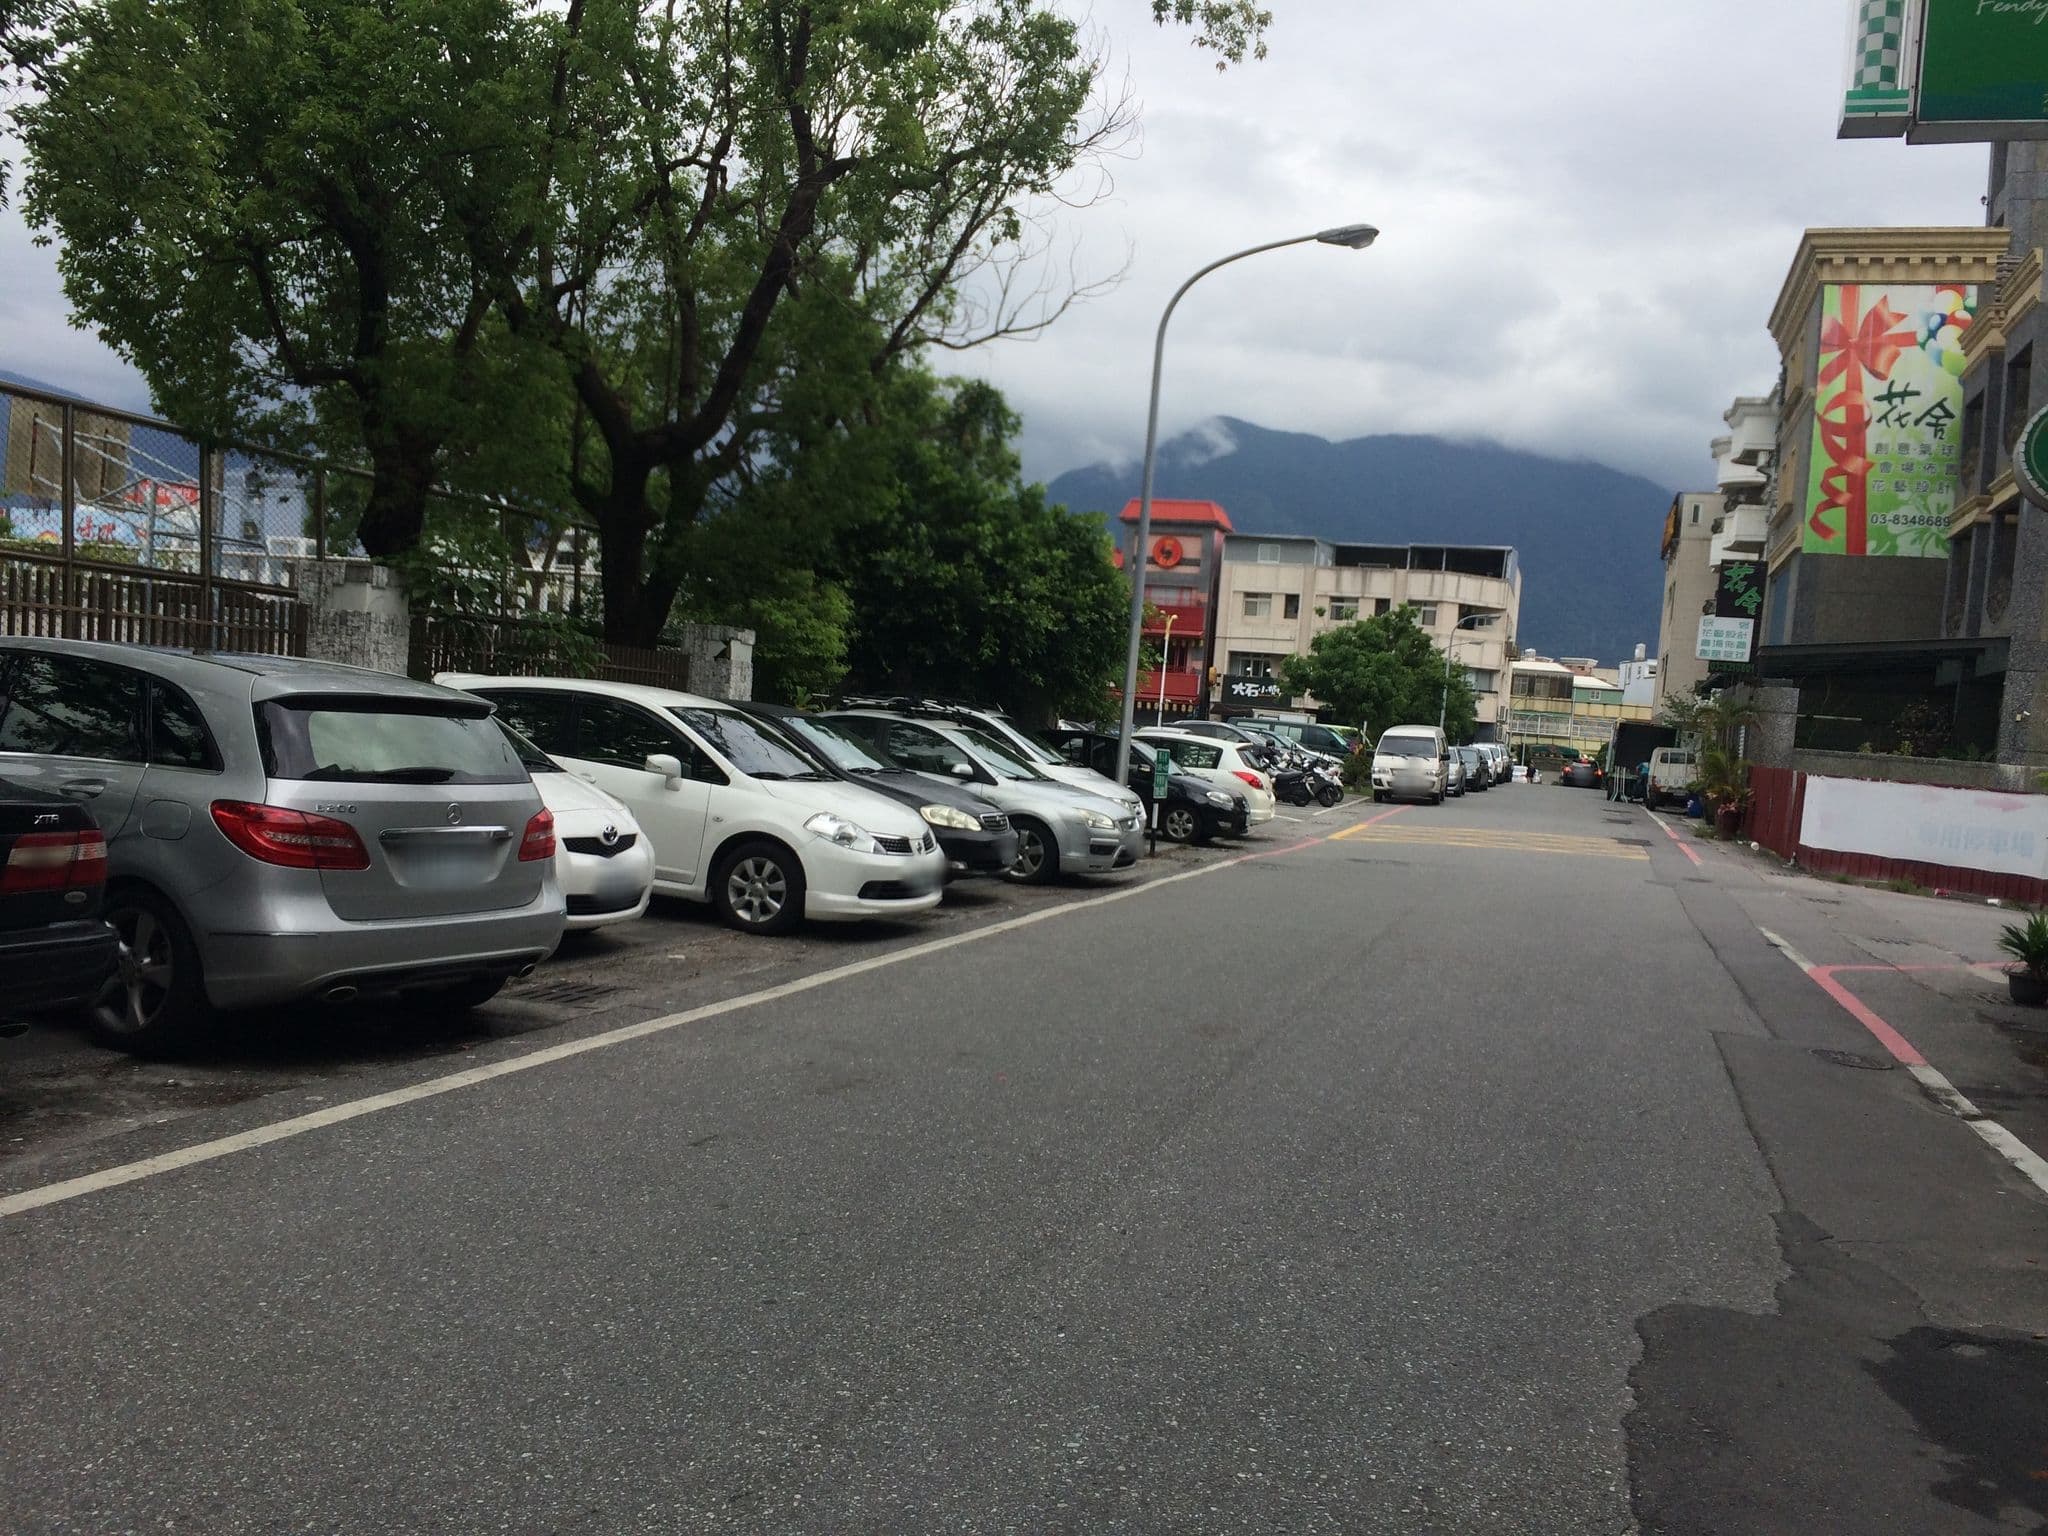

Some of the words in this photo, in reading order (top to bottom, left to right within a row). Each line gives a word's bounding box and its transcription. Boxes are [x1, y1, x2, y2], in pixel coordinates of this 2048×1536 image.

[1873, 379, 1956, 440] 花舍
[1870, 513, 1951, 527] 03-8348689
[1724, 562, 1762, 615] 花舍
